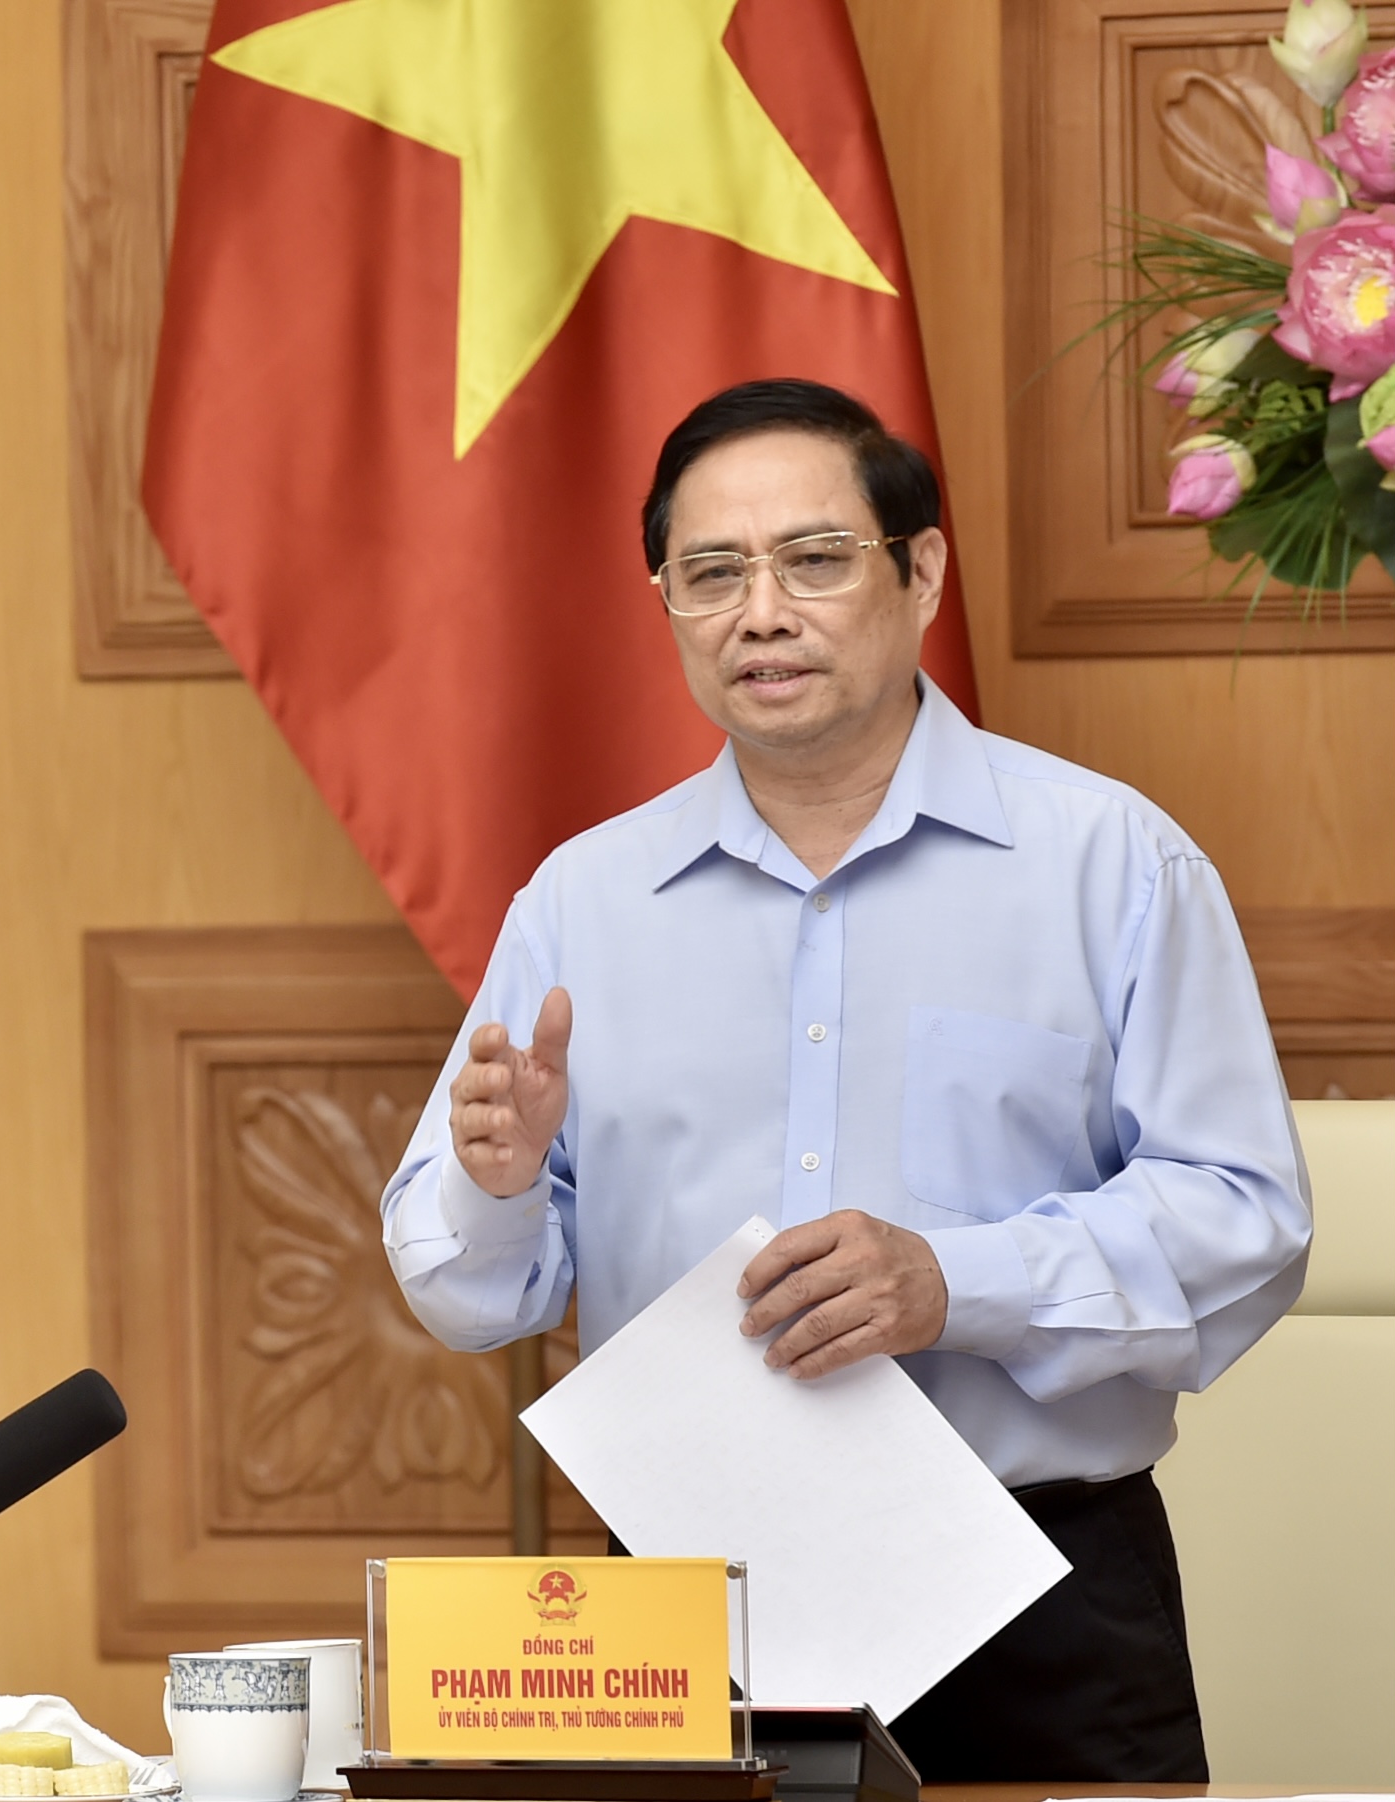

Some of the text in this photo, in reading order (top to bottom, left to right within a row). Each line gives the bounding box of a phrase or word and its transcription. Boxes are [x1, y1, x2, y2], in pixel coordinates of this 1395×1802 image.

[522, 1633, 594, 1656] ĐỒNG CHÍ
[431, 1662, 690, 1705] PHẠM MINH CHÍNH
[438, 1705, 453, 1729] ỦY
[455, 1706, 481, 1729] VIÊN
[483, 1707, 499, 1732] BỘ
[501, 1707, 535, 1729] CHÍNH
[537, 1710, 560, 1732] TRỊ,
[561, 1705, 583, 1729] THỦ
[624, 1707, 659, 1729] CHÍNH
[661, 1704, 685, 1729] PHỦ
